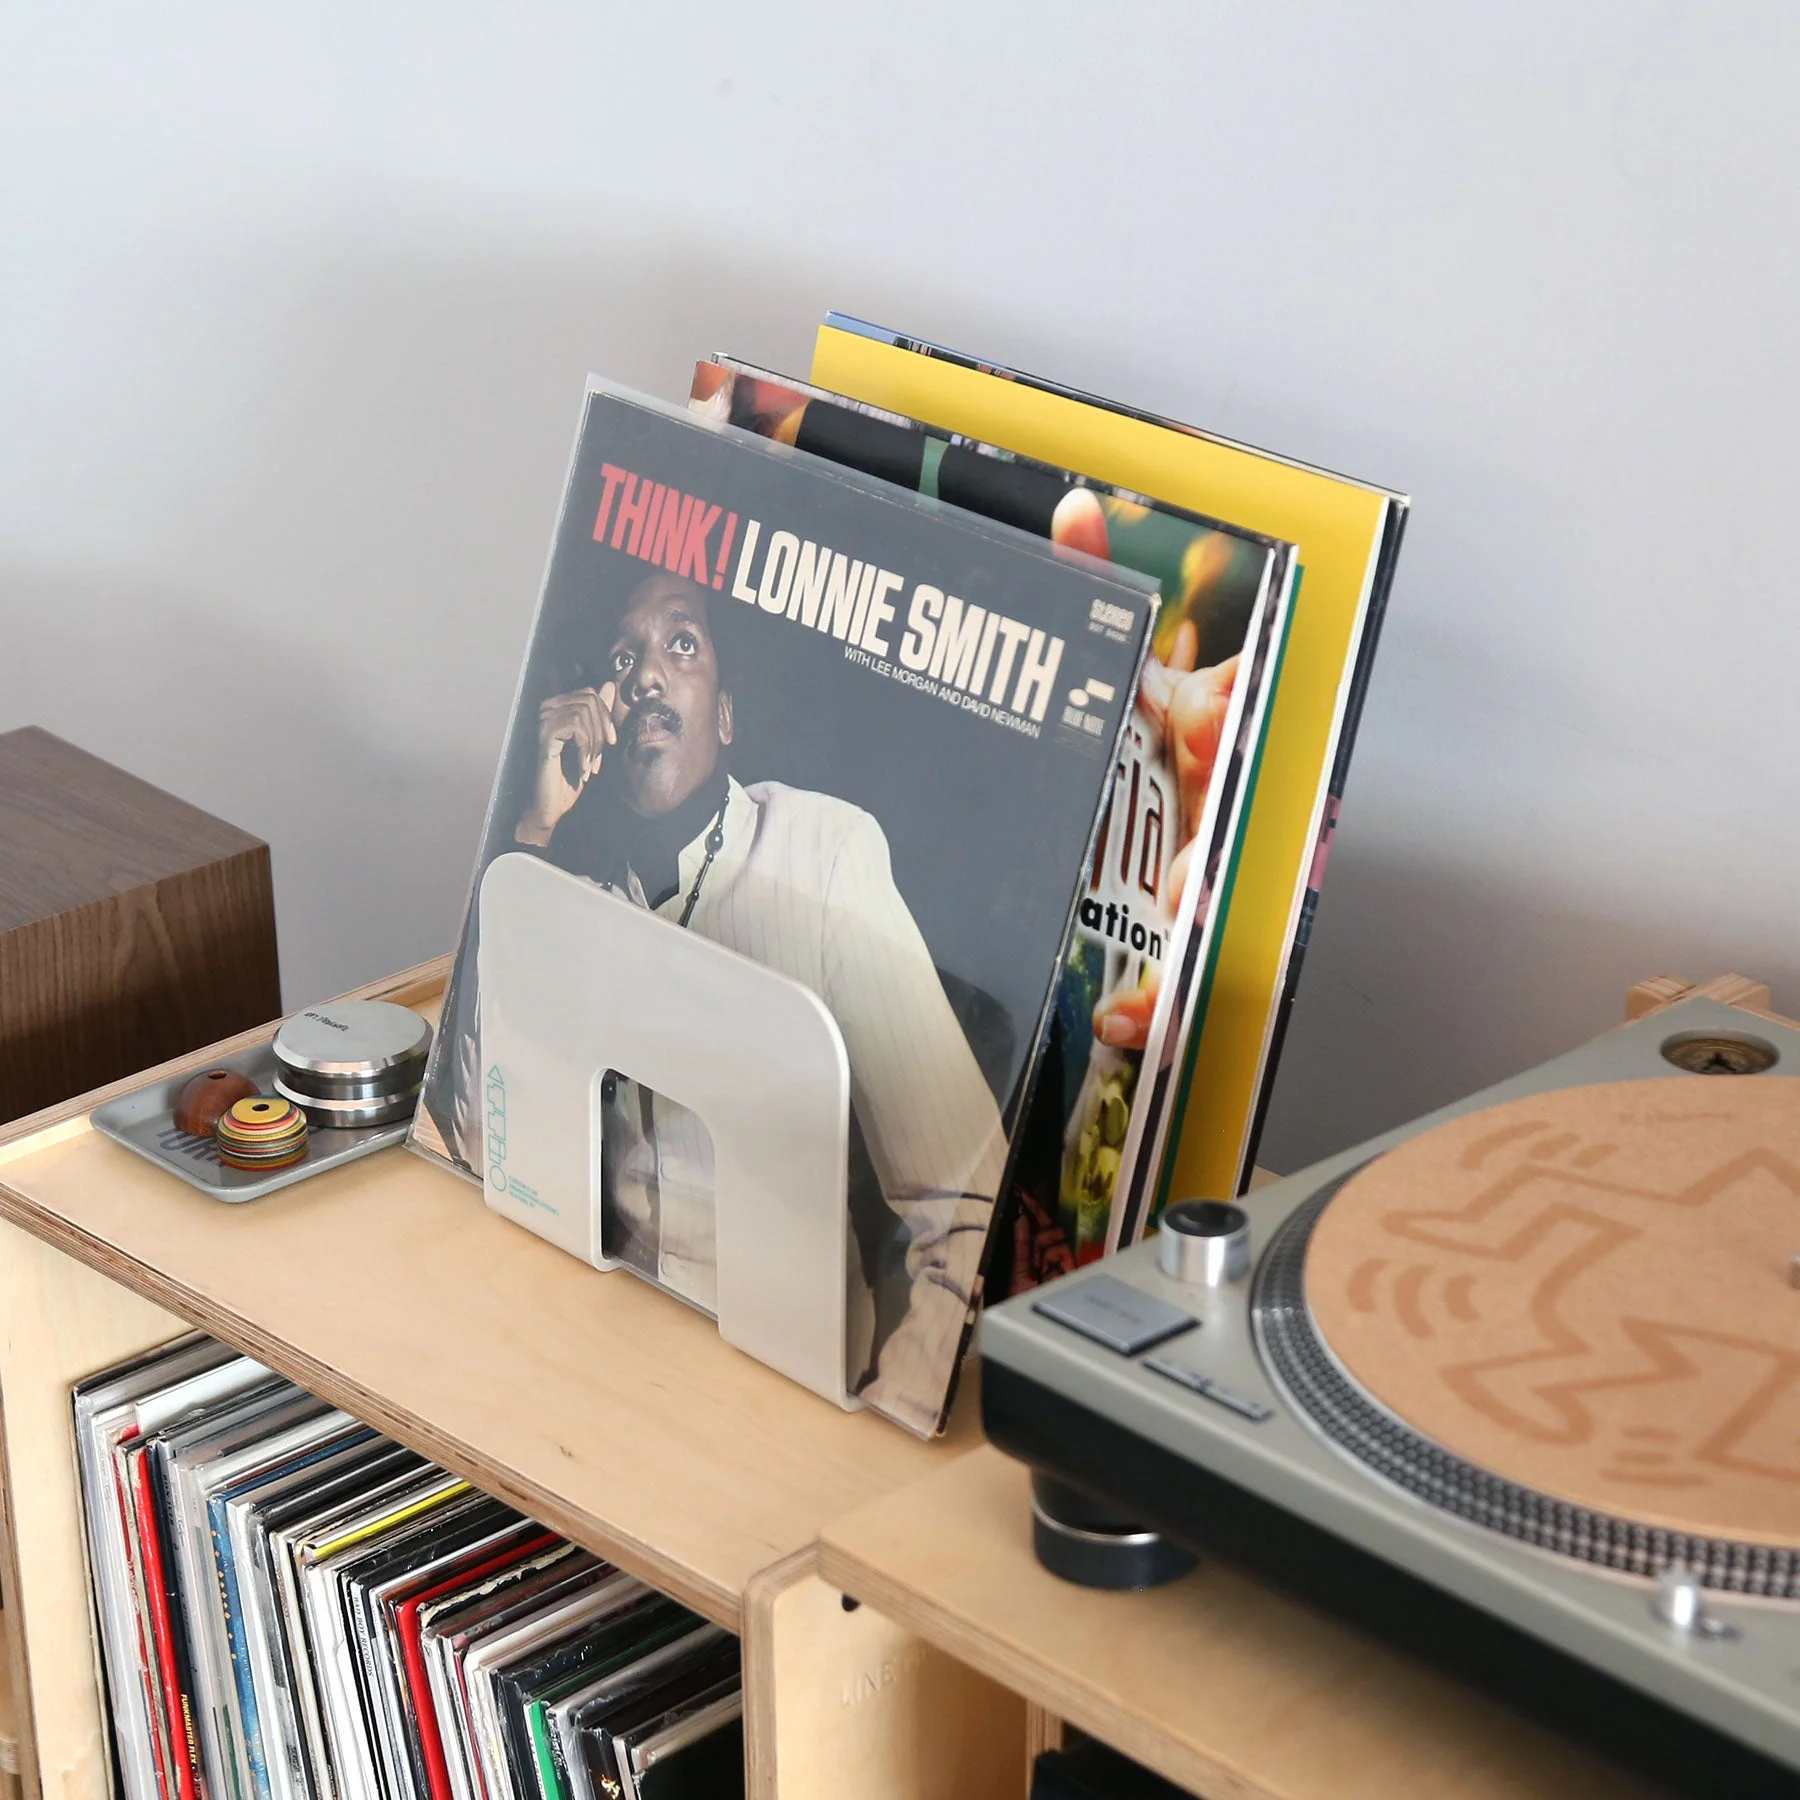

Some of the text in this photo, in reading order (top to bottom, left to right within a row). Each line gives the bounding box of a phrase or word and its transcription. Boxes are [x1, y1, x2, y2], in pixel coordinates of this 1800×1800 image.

[592, 462, 1065, 722] THINK! LONNIE SMITH
[844, 646, 1042, 740] WITH LEE MORGAN AND DAVID NEWMAN
[356, 1616, 366, 1636] BOY
[360, 1637, 374, 1677] RECORDS
[181, 1693, 197, 1764] FUNKMASTER FLEX
